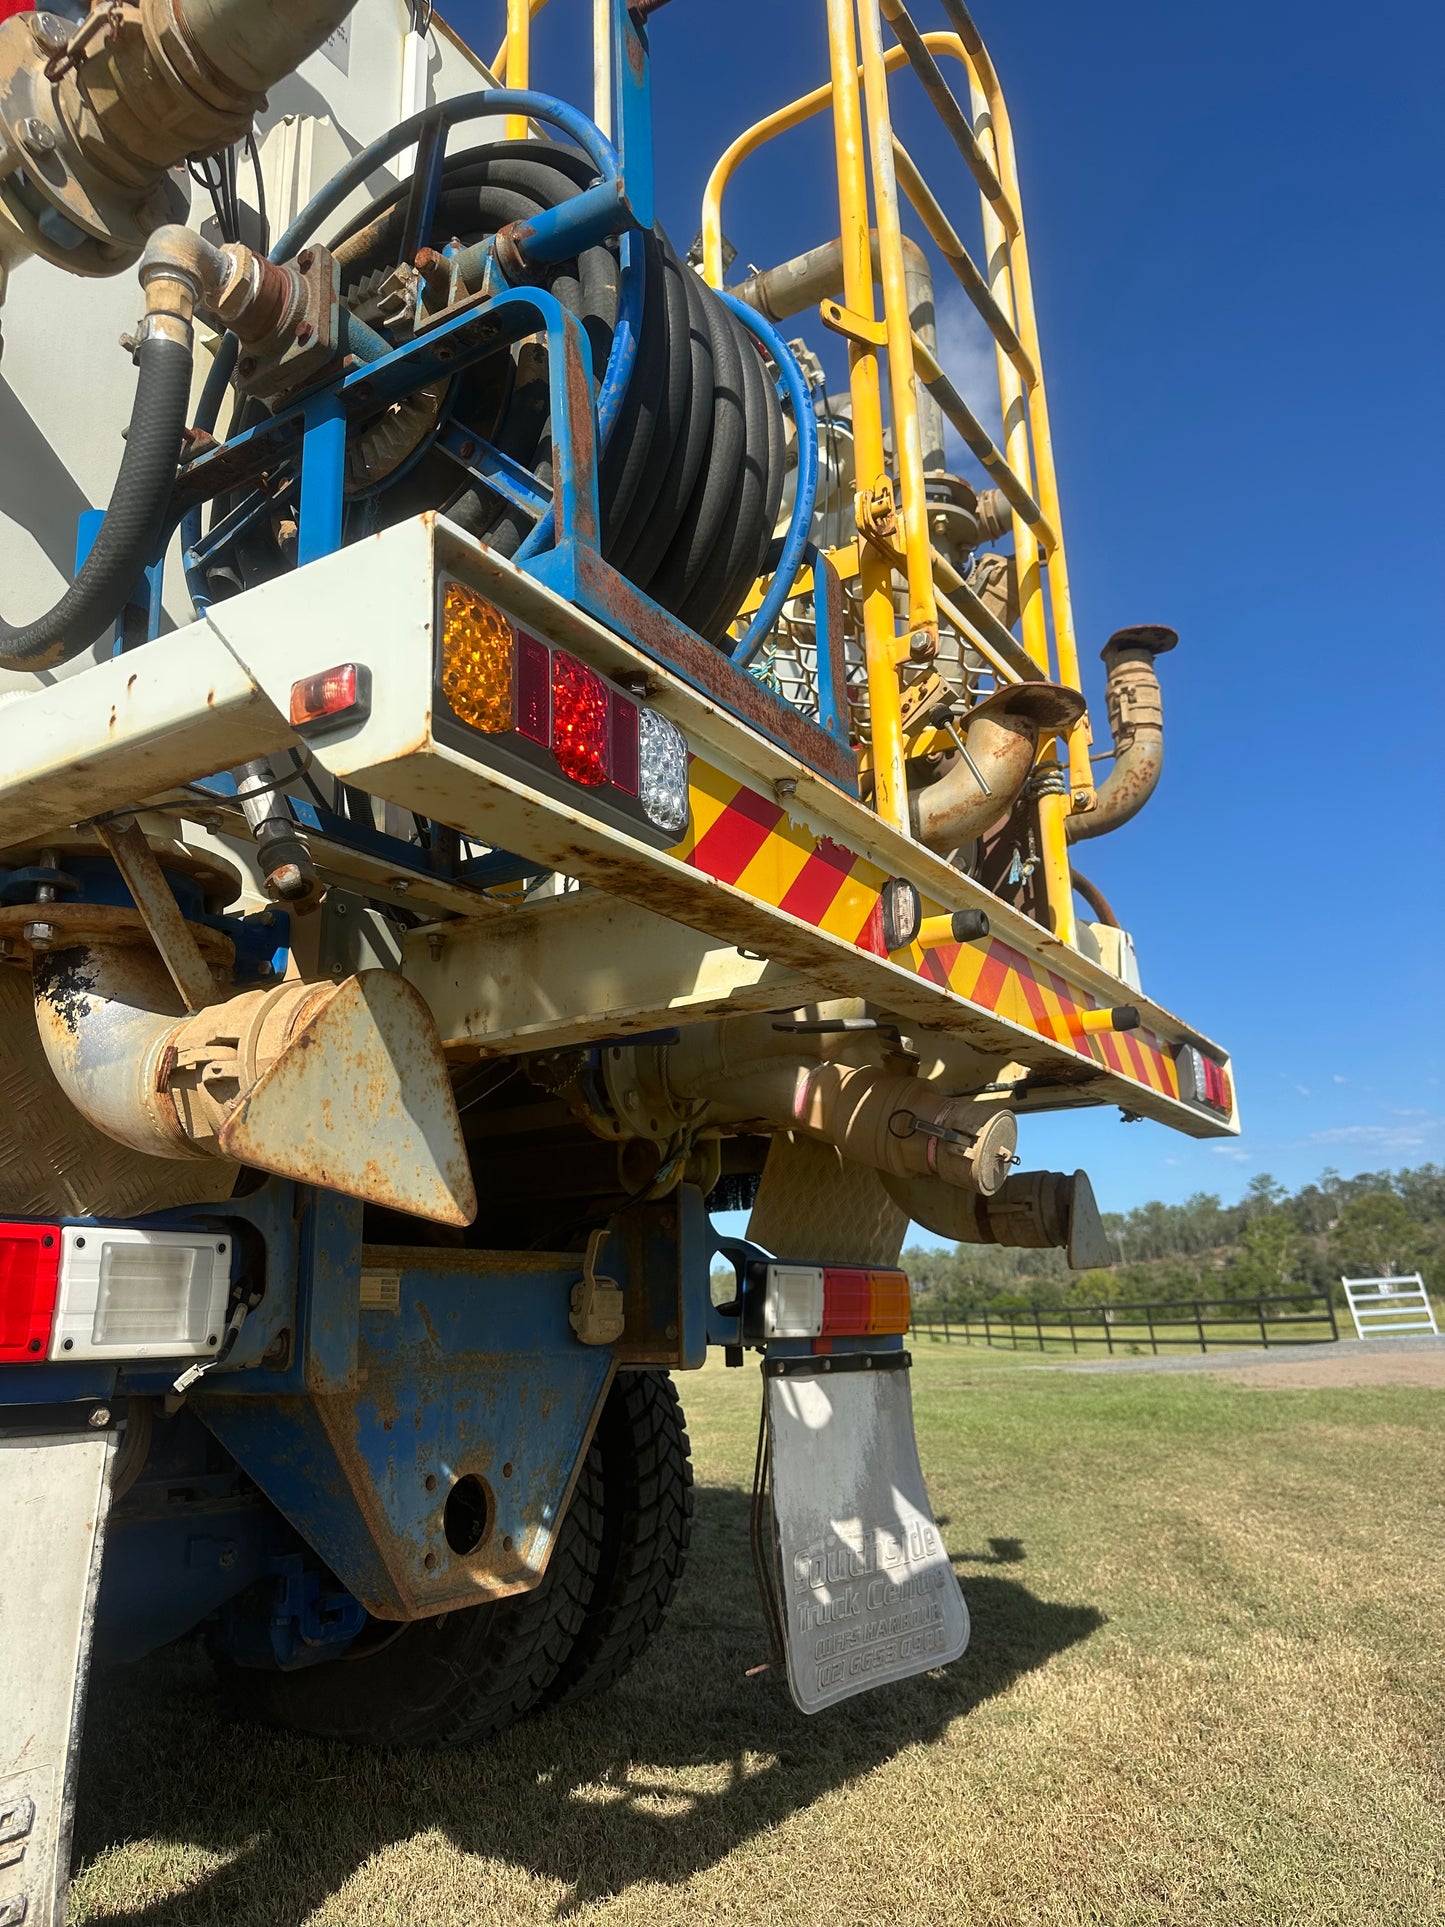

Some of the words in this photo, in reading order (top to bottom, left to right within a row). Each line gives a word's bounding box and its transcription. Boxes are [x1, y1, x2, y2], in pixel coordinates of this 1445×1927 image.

[793, 1521, 937, 1594] Southside
[797, 1587, 860, 1633] Truck
[867, 1568, 946, 1612] Centre
[815, 1626, 863, 1659] COFFS
[863, 1603, 943, 1641] HARBOUR
